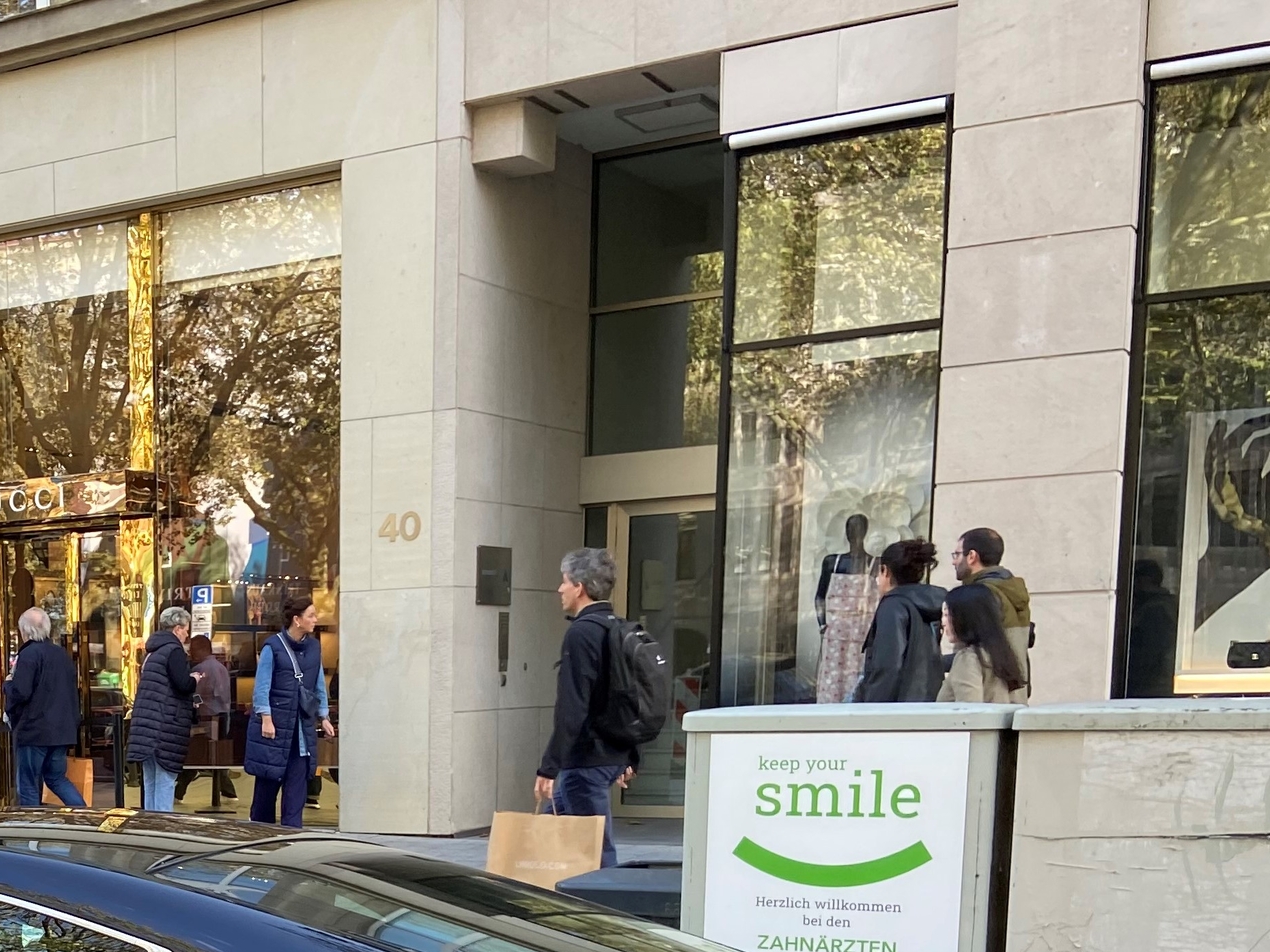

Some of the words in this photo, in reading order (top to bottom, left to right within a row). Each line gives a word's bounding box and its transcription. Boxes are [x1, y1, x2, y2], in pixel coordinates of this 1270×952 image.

[378, 510, 422, 543] 40
[758, 756, 800, 774] keep
[806, 758, 847, 774] your
[756, 769, 921, 818] smile
[755, 896, 810, 909] Herzlich
[815, 899, 901, 913] willkommen
[803, 915, 822, 927] bei
[826, 915, 851, 928] den
